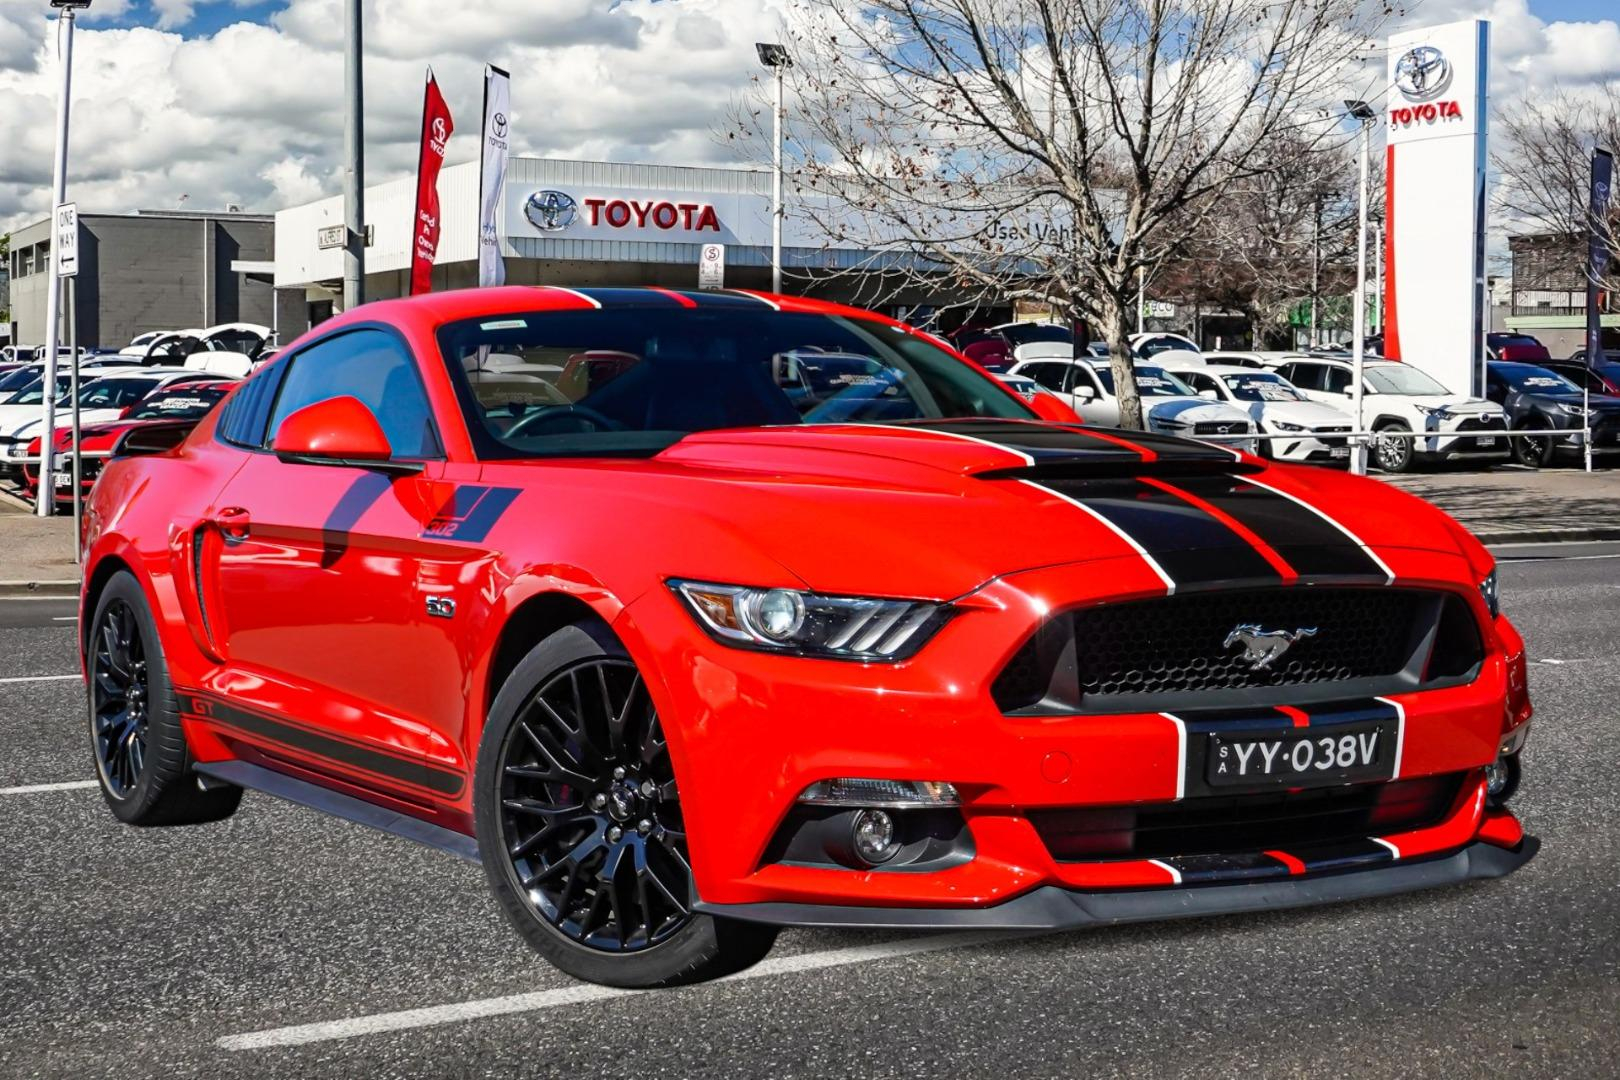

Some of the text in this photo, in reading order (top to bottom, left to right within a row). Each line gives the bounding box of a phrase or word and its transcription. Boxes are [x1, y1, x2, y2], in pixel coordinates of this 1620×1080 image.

[1390, 101, 1463, 126] TOYOTA
[60, 209, 74, 228] ONE
[584, 198, 720, 232] TOYOTA
[59, 231, 75, 249] WAY
[191, 697, 214, 716] GT
